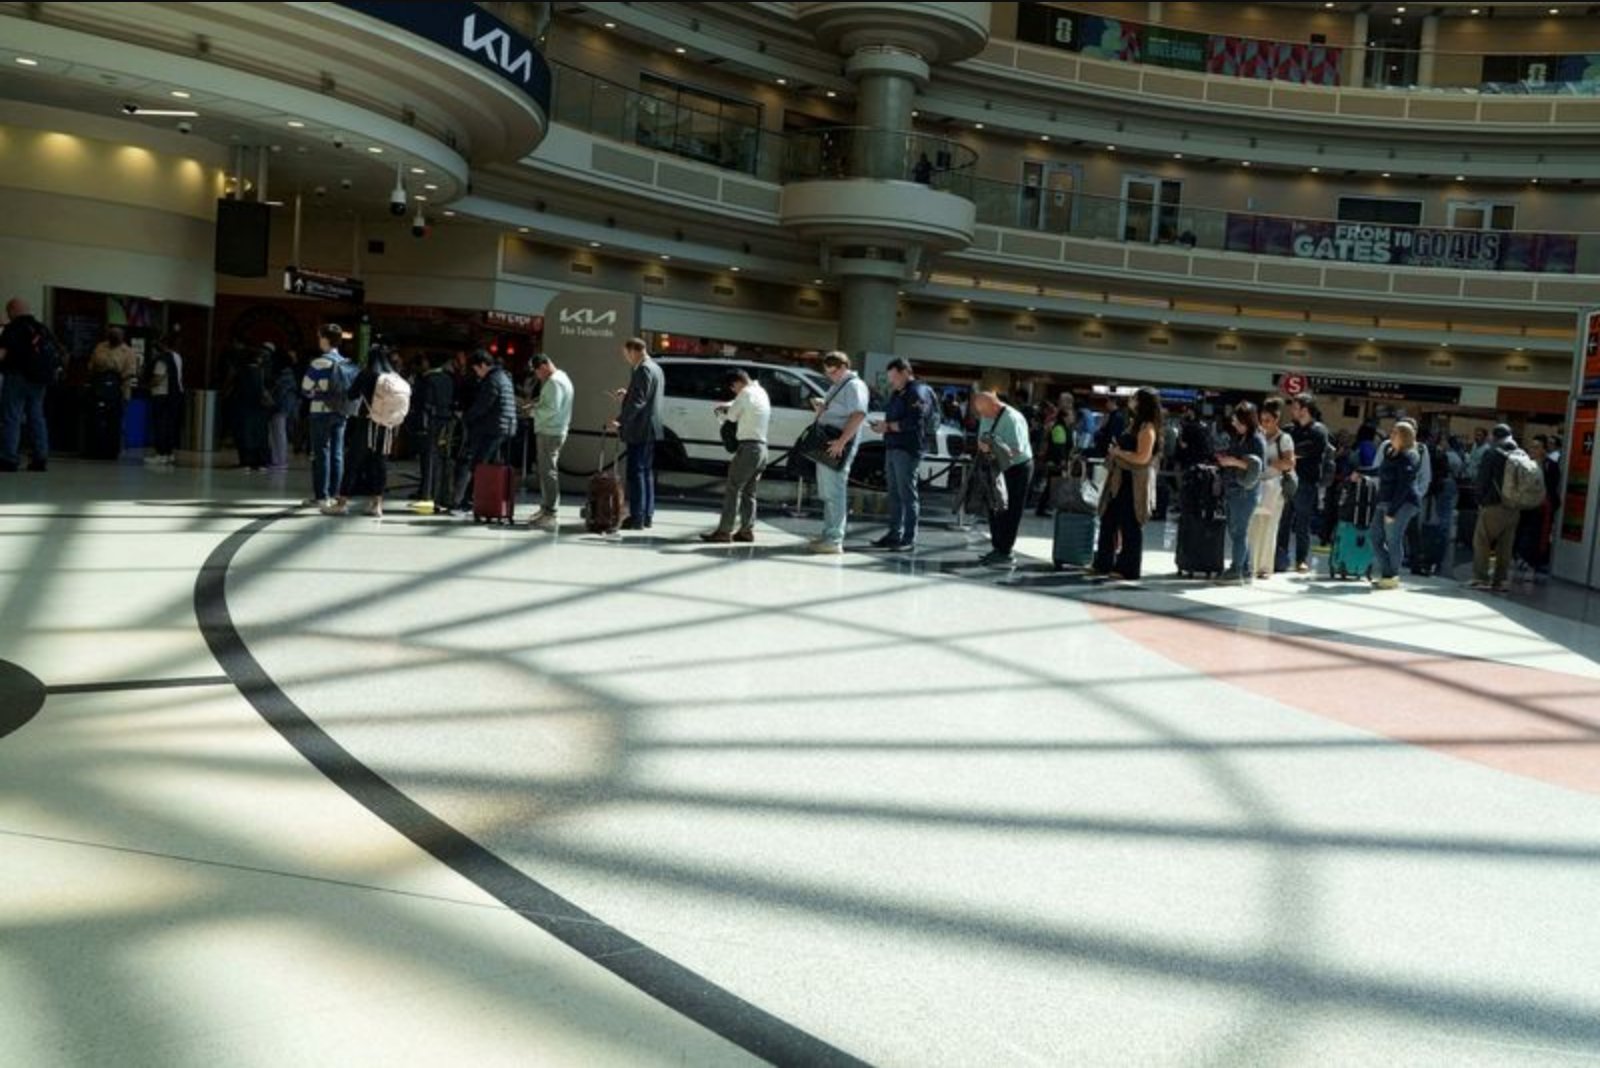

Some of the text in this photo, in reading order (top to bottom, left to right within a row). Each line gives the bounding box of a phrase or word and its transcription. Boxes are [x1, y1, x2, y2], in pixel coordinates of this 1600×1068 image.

[462, 13, 532, 83] KIA
[1335, 225, 1391, 241] FROM
[1293, 235, 1392, 264] GATES
[1394, 229, 1500, 262] TO GOALS
[559, 308, 617, 325] KIA
[1287, 376, 1302, 393] S
